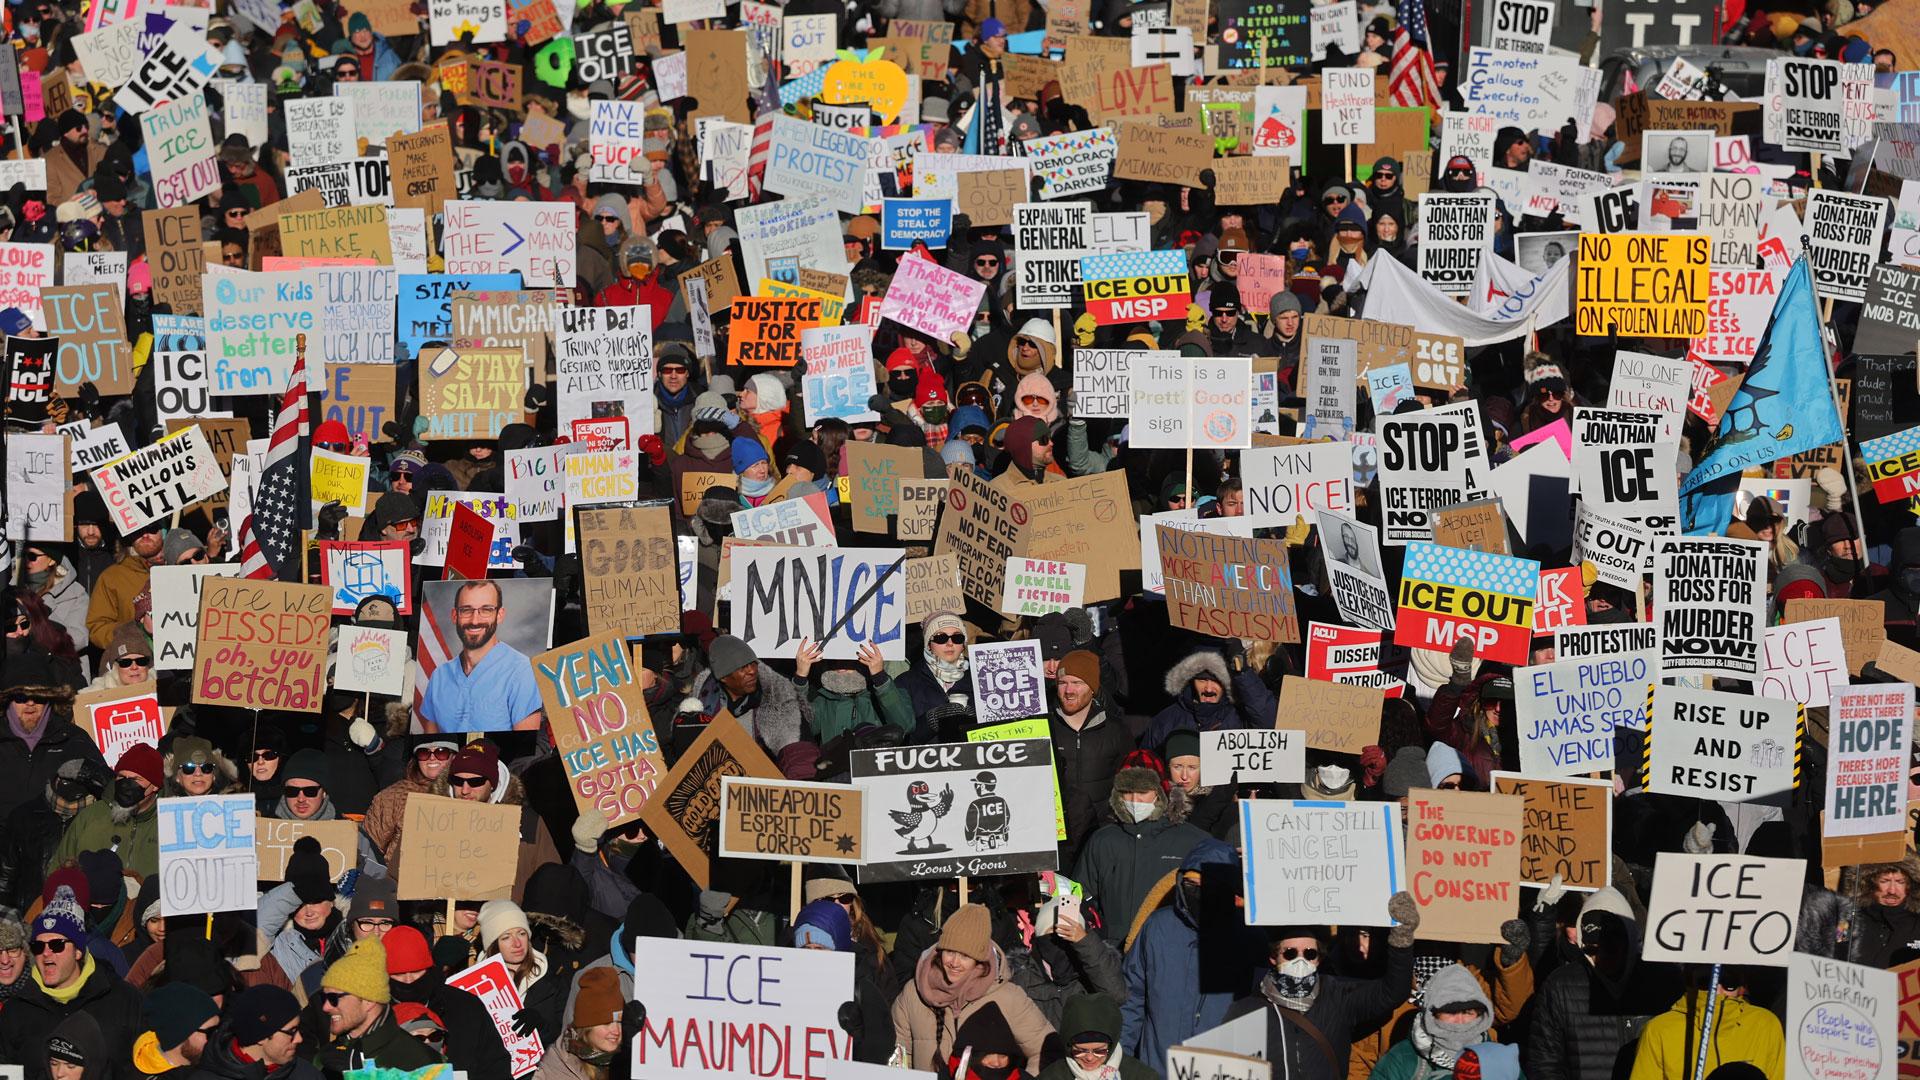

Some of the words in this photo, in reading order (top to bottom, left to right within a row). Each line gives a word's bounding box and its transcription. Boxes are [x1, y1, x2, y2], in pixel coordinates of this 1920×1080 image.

[793, 18, 828, 33] ICE
[576, 29, 632, 63] ICE
[792, 33, 826, 48] OUT
[579, 50, 633, 82] OUT
[1100, 64, 1168, 112] LOVE
[1328, 72, 1371, 90] FUND
[1785, 62, 1838, 99] STOP
[226, 85, 263, 104] FREE
[144, 95, 205, 137] TRUMP
[231, 105, 263, 119] LIAM
[598, 104, 633, 120] MN
[1339, 108, 1363, 121] NOT
[1786, 109, 1804, 127] ICE
[1805, 112, 1840, 128] TERROR
[592, 121, 640, 138] NICE
[1332, 121, 1359, 136] ICE
[160, 129, 206, 162] ICE
[391, 133, 445, 153] IMMIGRANTS
[812, 130, 868, 159] LEGENDS
[773, 148, 860, 184] PROTEST
[1034, 148, 1116, 171] DEMOCRACY
[1077, 164, 1104, 176] DIES
[156, 167, 189, 208] GET
[191, 156, 221, 194] OUT
[407, 178, 439, 196] GREAT
[971, 171, 1016, 188] ICE
[1709, 178, 1751, 201] NO
[970, 190, 1015, 205] OUT
[1424, 197, 1491, 206] ARREST
[1812, 193, 1883, 210] ARREST
[282, 208, 385, 234] IMMIGRANTS
[446, 205, 482, 230] WE
[897, 208, 921, 218] STOP
[923, 207, 941, 217] THE
[898, 219, 926, 229] STEAL
[929, 219, 941, 228] OF
[1019, 209, 1062, 226] EXPAND
[1064, 209, 1086, 225] THE
[1427, 206, 1488, 223] JONATHAN
[1700, 202, 1760, 227] HUMAN
[1812, 204, 1878, 229] JONATHAN
[446, 233, 494, 255] THE
[891, 229, 946, 240] DEMOCRACY
[1020, 228, 1086, 250] GENERAL
[1428, 224, 1459, 241] ROSS
[1461, 224, 1484, 241] FOR
[301, 234, 359, 256] MAKE
[1580, 238, 1611, 262] NO
[1627, 238, 1668, 262] ONE
[1686, 238, 1708, 264] IS
[88, 254, 105, 265] ICE
[1086, 279, 1128, 299] ICE
[1133, 275, 1187, 294] OUT
[1579, 266, 1706, 302] ILLEGAL
[44, 290, 118, 335] ICE
[209, 308, 313, 332] deserve
[731, 300, 821, 322] JUSTICE
[1111, 297, 1168, 320] MSP
[758, 321, 795, 342] FOR
[1579, 308, 1603, 333] ON
[1608, 307, 1658, 336] STOLEN
[1664, 308, 1704, 335] LAND
[806, 337, 865, 361] BEAUTIFUL
[1320, 343, 1340, 354] GETTA
[1321, 355, 1339, 366] MOVE
[1416, 339, 1459, 362] ICE
[56, 340, 121, 385] OUT
[216, 359, 272, 390] from
[455, 354, 521, 382] STAY
[1417, 361, 1460, 385] OUT
[9, 370, 50, 402] ICE
[1149, 416, 1183, 433] sign
[1576, 410, 1663, 424] ARREST
[1382, 421, 1459, 472] STOP
[313, 456, 362, 479] DEFEND
[566, 452, 615, 475] HUMAN
[1274, 451, 1312, 477] MN
[1599, 448, 1658, 503] ICE
[327, 479, 344, 489] OUR
[581, 470, 635, 498] RIGHTS
[1385, 487, 1406, 508] ICE
[1409, 487, 1462, 510] TERROR
[1161, 529, 1288, 565] NOTHING'S
[1661, 542, 1761, 557] ARREST
[1025, 560, 1067, 575] MAKE
[1163, 555, 1202, 583] MORE
[1211, 562, 1293, 592] AMERICAN
[1665, 555, 1756, 581] JONATHAN
[589, 574, 666, 601] HUMAN
[1015, 575, 1072, 590] ORWELL
[1669, 579, 1715, 602] ROSS
[1718, 580, 1752, 604] FOR
[210, 586, 269, 610] are
[282, 590, 326, 614] we
[1402, 580, 1456, 613] ICE
[1461, 590, 1534, 625] OUT
[204, 608, 330, 646] PISSED?
[1178, 602, 1297, 641] FASCISM!
[1313, 627, 1337, 639] ACLU
[1663, 609, 1754, 641] MURDER
[216, 644, 253, 667] oh,
[269, 647, 313, 670] you
[1662, 638, 1757, 658] NOW!
[200, 660, 321, 709] betcha!
[537, 638, 632, 709] YEAH
[985, 669, 1029, 689] ICE
[1533, 671, 1558, 697] EL
[1579, 658, 1646, 688] PUEBLO
[986, 690, 1035, 710] OUT
[1555, 688, 1623, 716] UNIDO
[571, 691, 628, 743] NO
[1673, 702, 1726, 726] RISE
[1739, 709, 1770, 731] UP
[1217, 731, 1288, 751] ABOLISH
[1694, 737, 1742, 759] AND
[1839, 719, 1903, 754] HOPE
[564, 745, 610, 778] ICE
[614, 729, 658, 762] HAS
[875, 746, 962, 772] FUCK
[976, 742, 1029, 765] ICE
[1232, 752, 1273, 772] ICE
[1671, 766, 1758, 794] RESIST
[683, 792, 711, 832] HOLD
[727, 785, 842, 820] MINNEAPOLIS
[981, 802, 1004, 818] ICE
[1416, 800, 1444, 821] THE
[159, 799, 254, 852] ICE
[415, 806, 457, 832] Not
[469, 809, 505, 832] Paid
[740, 813, 802, 838] ESPRIT
[810, 819, 834, 842] DE
[756, 831, 811, 856] CORPS
[1415, 822, 1516, 847] GOVERNED
[422, 838, 448, 861] to
[459, 839, 488, 859] Be
[1421, 850, 1444, 866] DO
[1452, 850, 1493, 868] NOT
[423, 864, 481, 889] Here
[911, 859, 952, 877] Loons
[968, 858, 1008, 874] Goons
[1282, 864, 1358, 883] WITHOUT
[163, 855, 256, 911] OUT
[1413, 870, 1511, 906] CONSENT
[1691, 862, 1766, 900] ICE
[1288, 886, 1341, 913] ICE
[1655, 909, 1792, 954] GTFO
[686, 953, 782, 1007] ICE
[1811, 959, 1864, 988] VENN
[1804, 980, 1878, 1018] DIAGRAM
[1816, 1008, 1852, 1029] People
